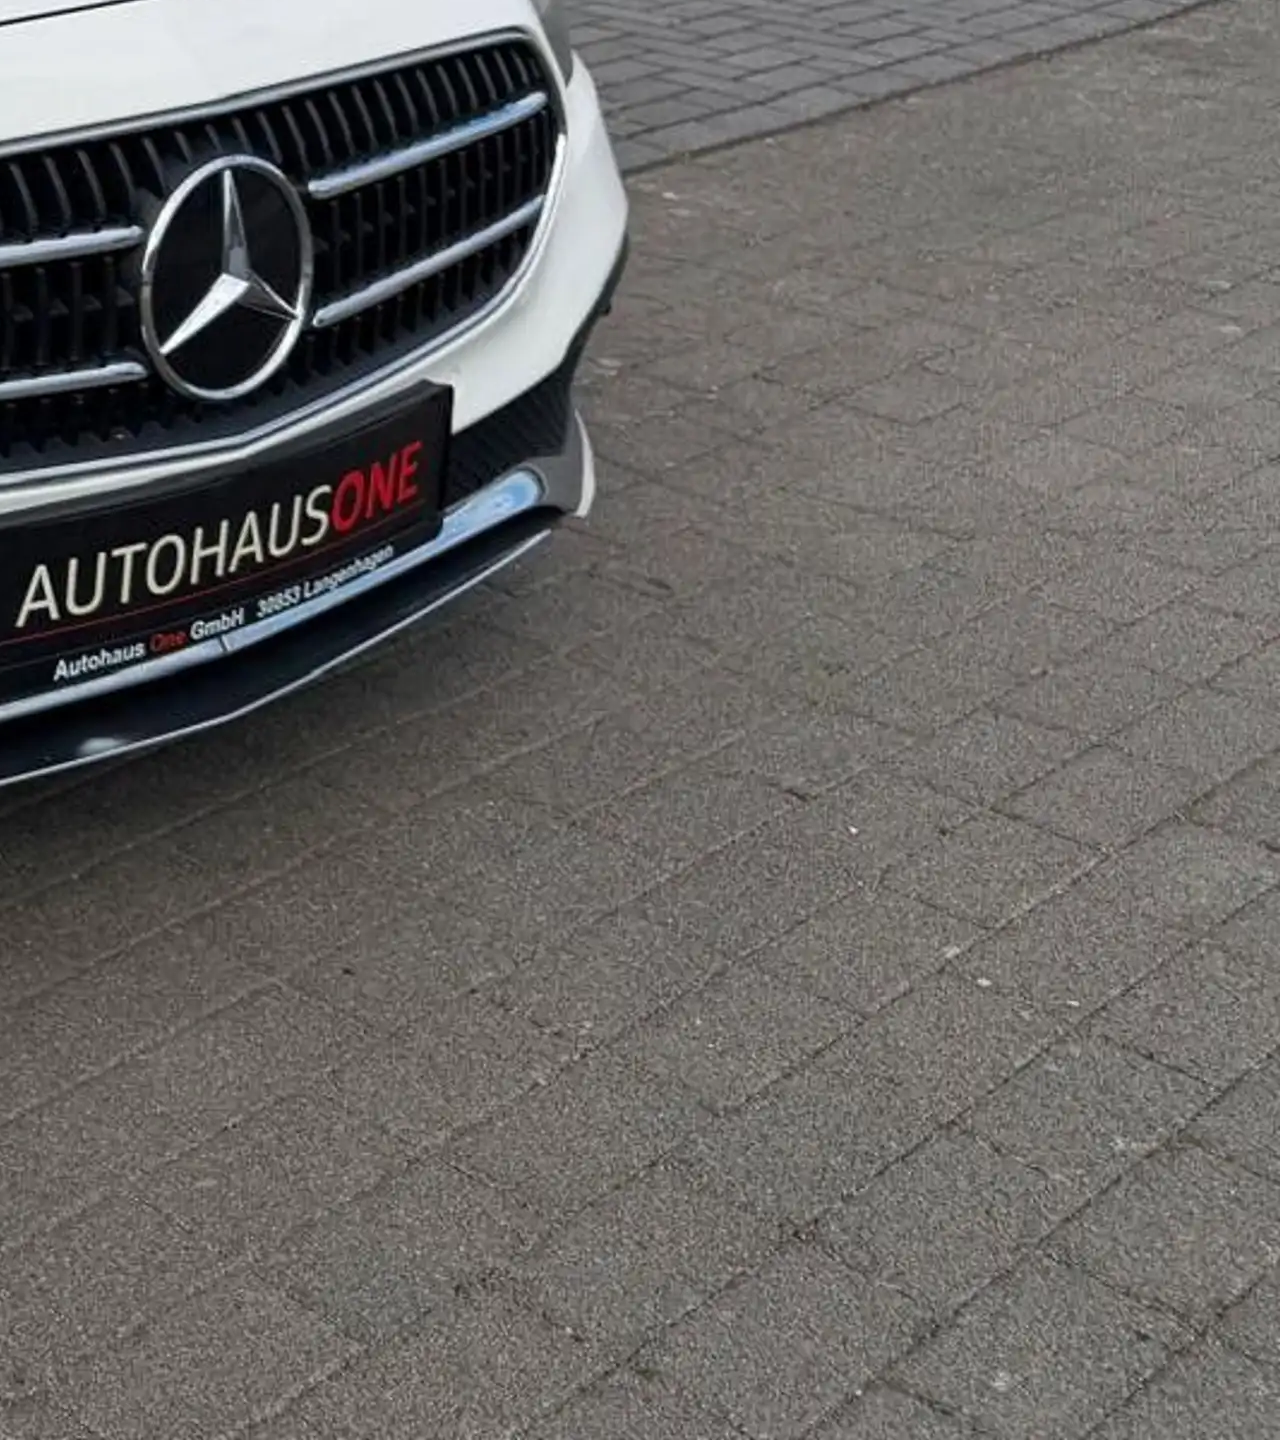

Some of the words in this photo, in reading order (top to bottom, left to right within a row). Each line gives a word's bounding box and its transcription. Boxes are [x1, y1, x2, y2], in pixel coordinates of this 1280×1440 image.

[53, 641, 146, 681] Autohaus
[150, 631, 188, 652] One
[190, 607, 245, 640] GmbH
[303, 545, 395, 599] Langenhagen
